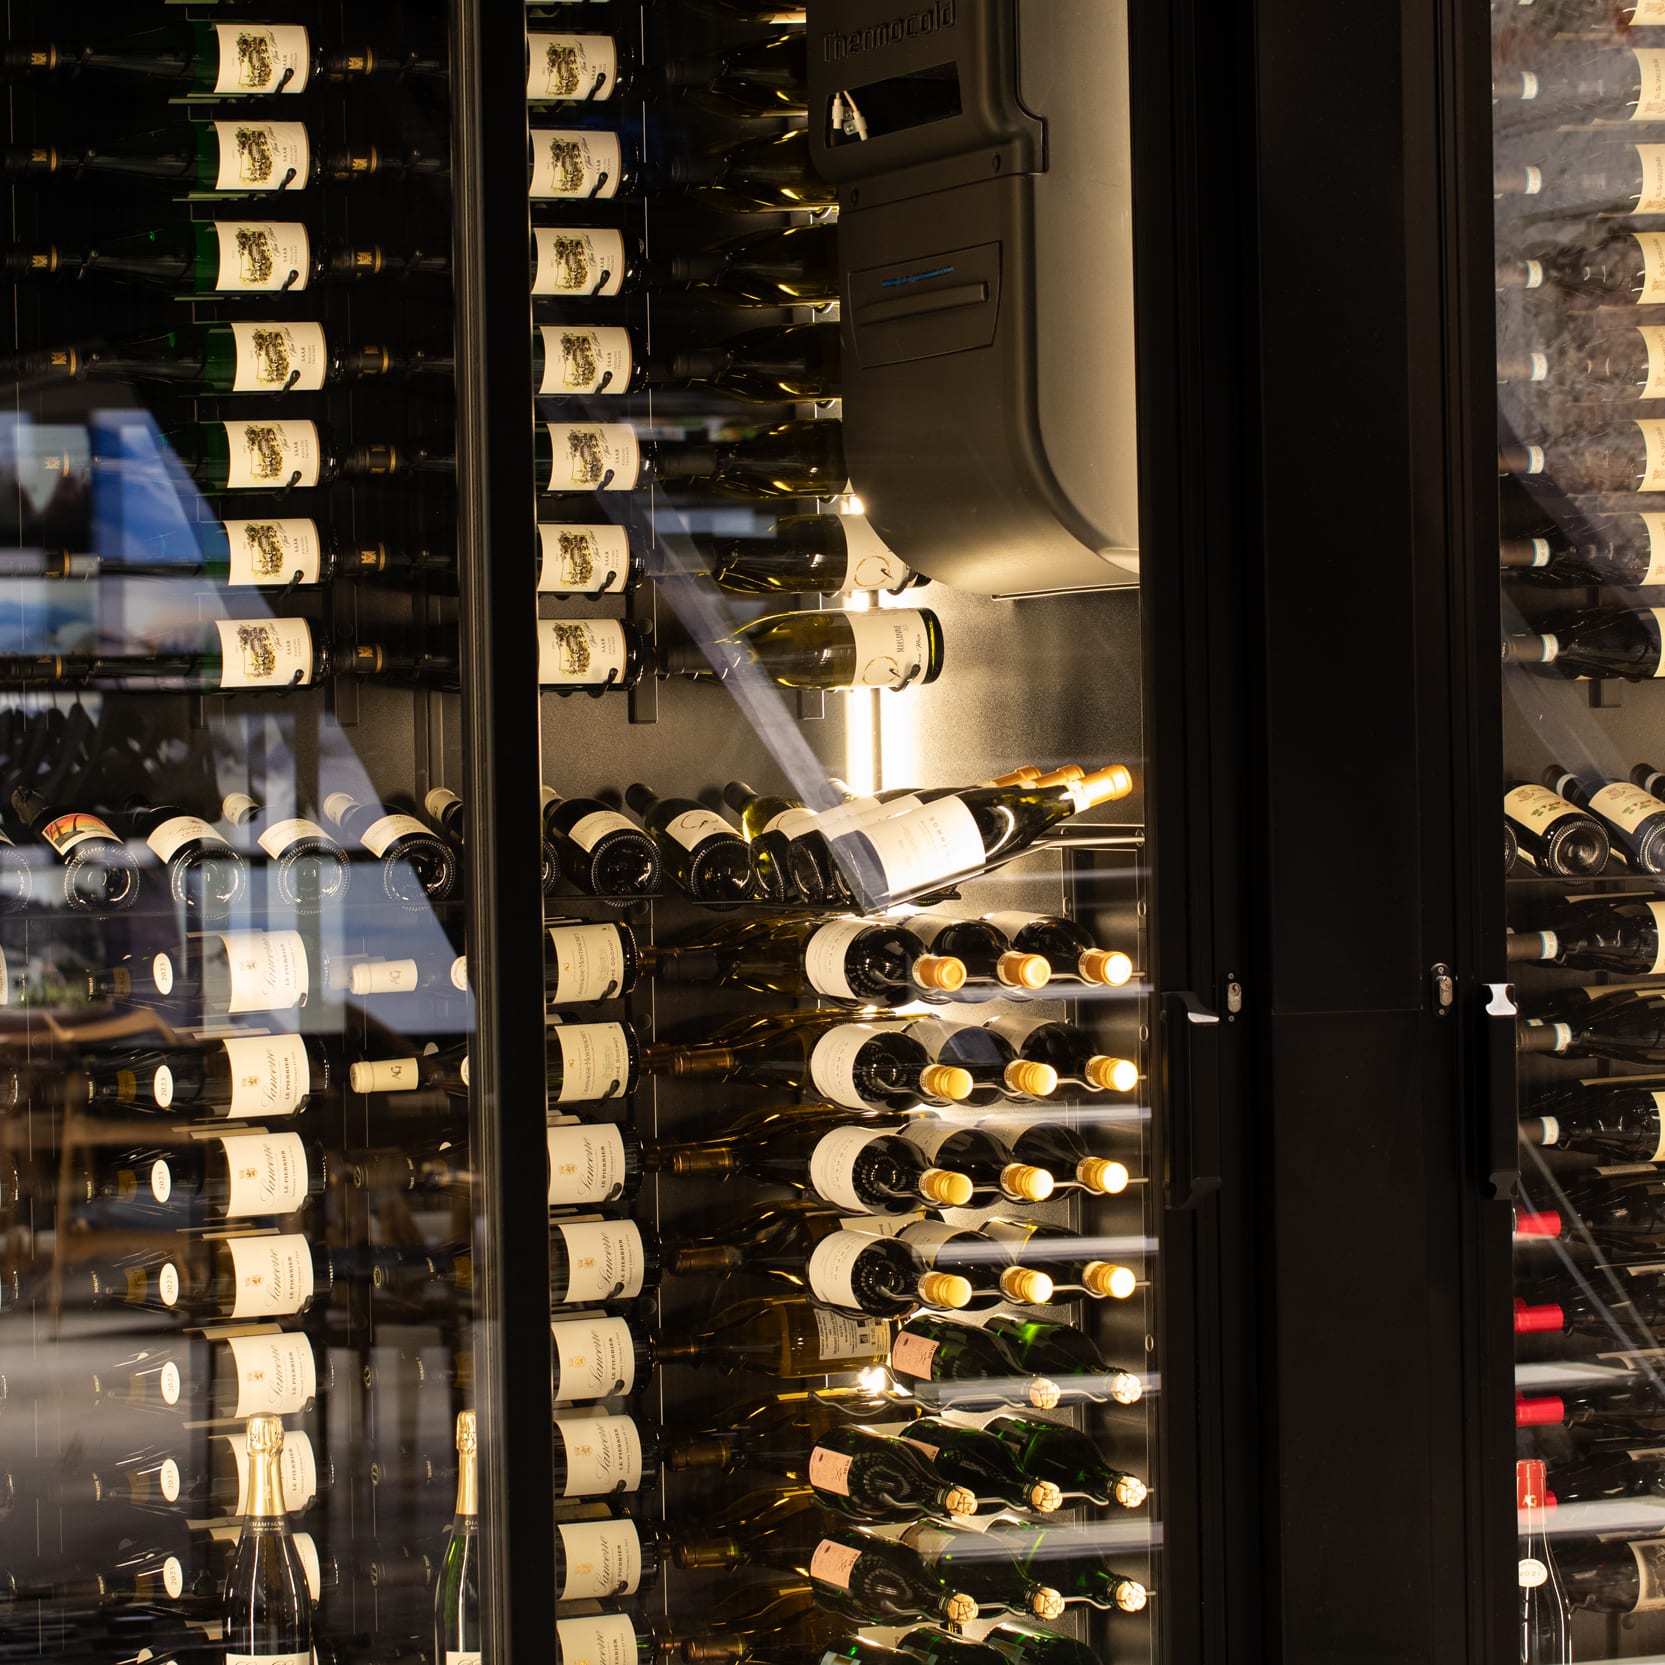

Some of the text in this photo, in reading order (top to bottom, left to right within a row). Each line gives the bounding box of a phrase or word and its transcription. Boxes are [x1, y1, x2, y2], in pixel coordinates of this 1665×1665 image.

[281, 1150, 289, 1183] PIERRIER
[577, 1137, 594, 1195] Sancerre
[597, 1231, 614, 1290] Sancerre
[618, 1239, 626, 1282] LE PIERRIER
[288, 1352, 297, 1385] PIERRIER
[587, 1329, 604, 1388] Sancerre
[608, 1337, 616, 1380] LE PIERRIER
[288, 1448, 297, 1480] PIERRIER
[596, 1423, 612, 1485] Sancerre
[614, 1428, 624, 1470] LE PIERRIER
[1522, 1494, 1537, 1508] AG
[593, 1536, 610, 1593] Sancerre
